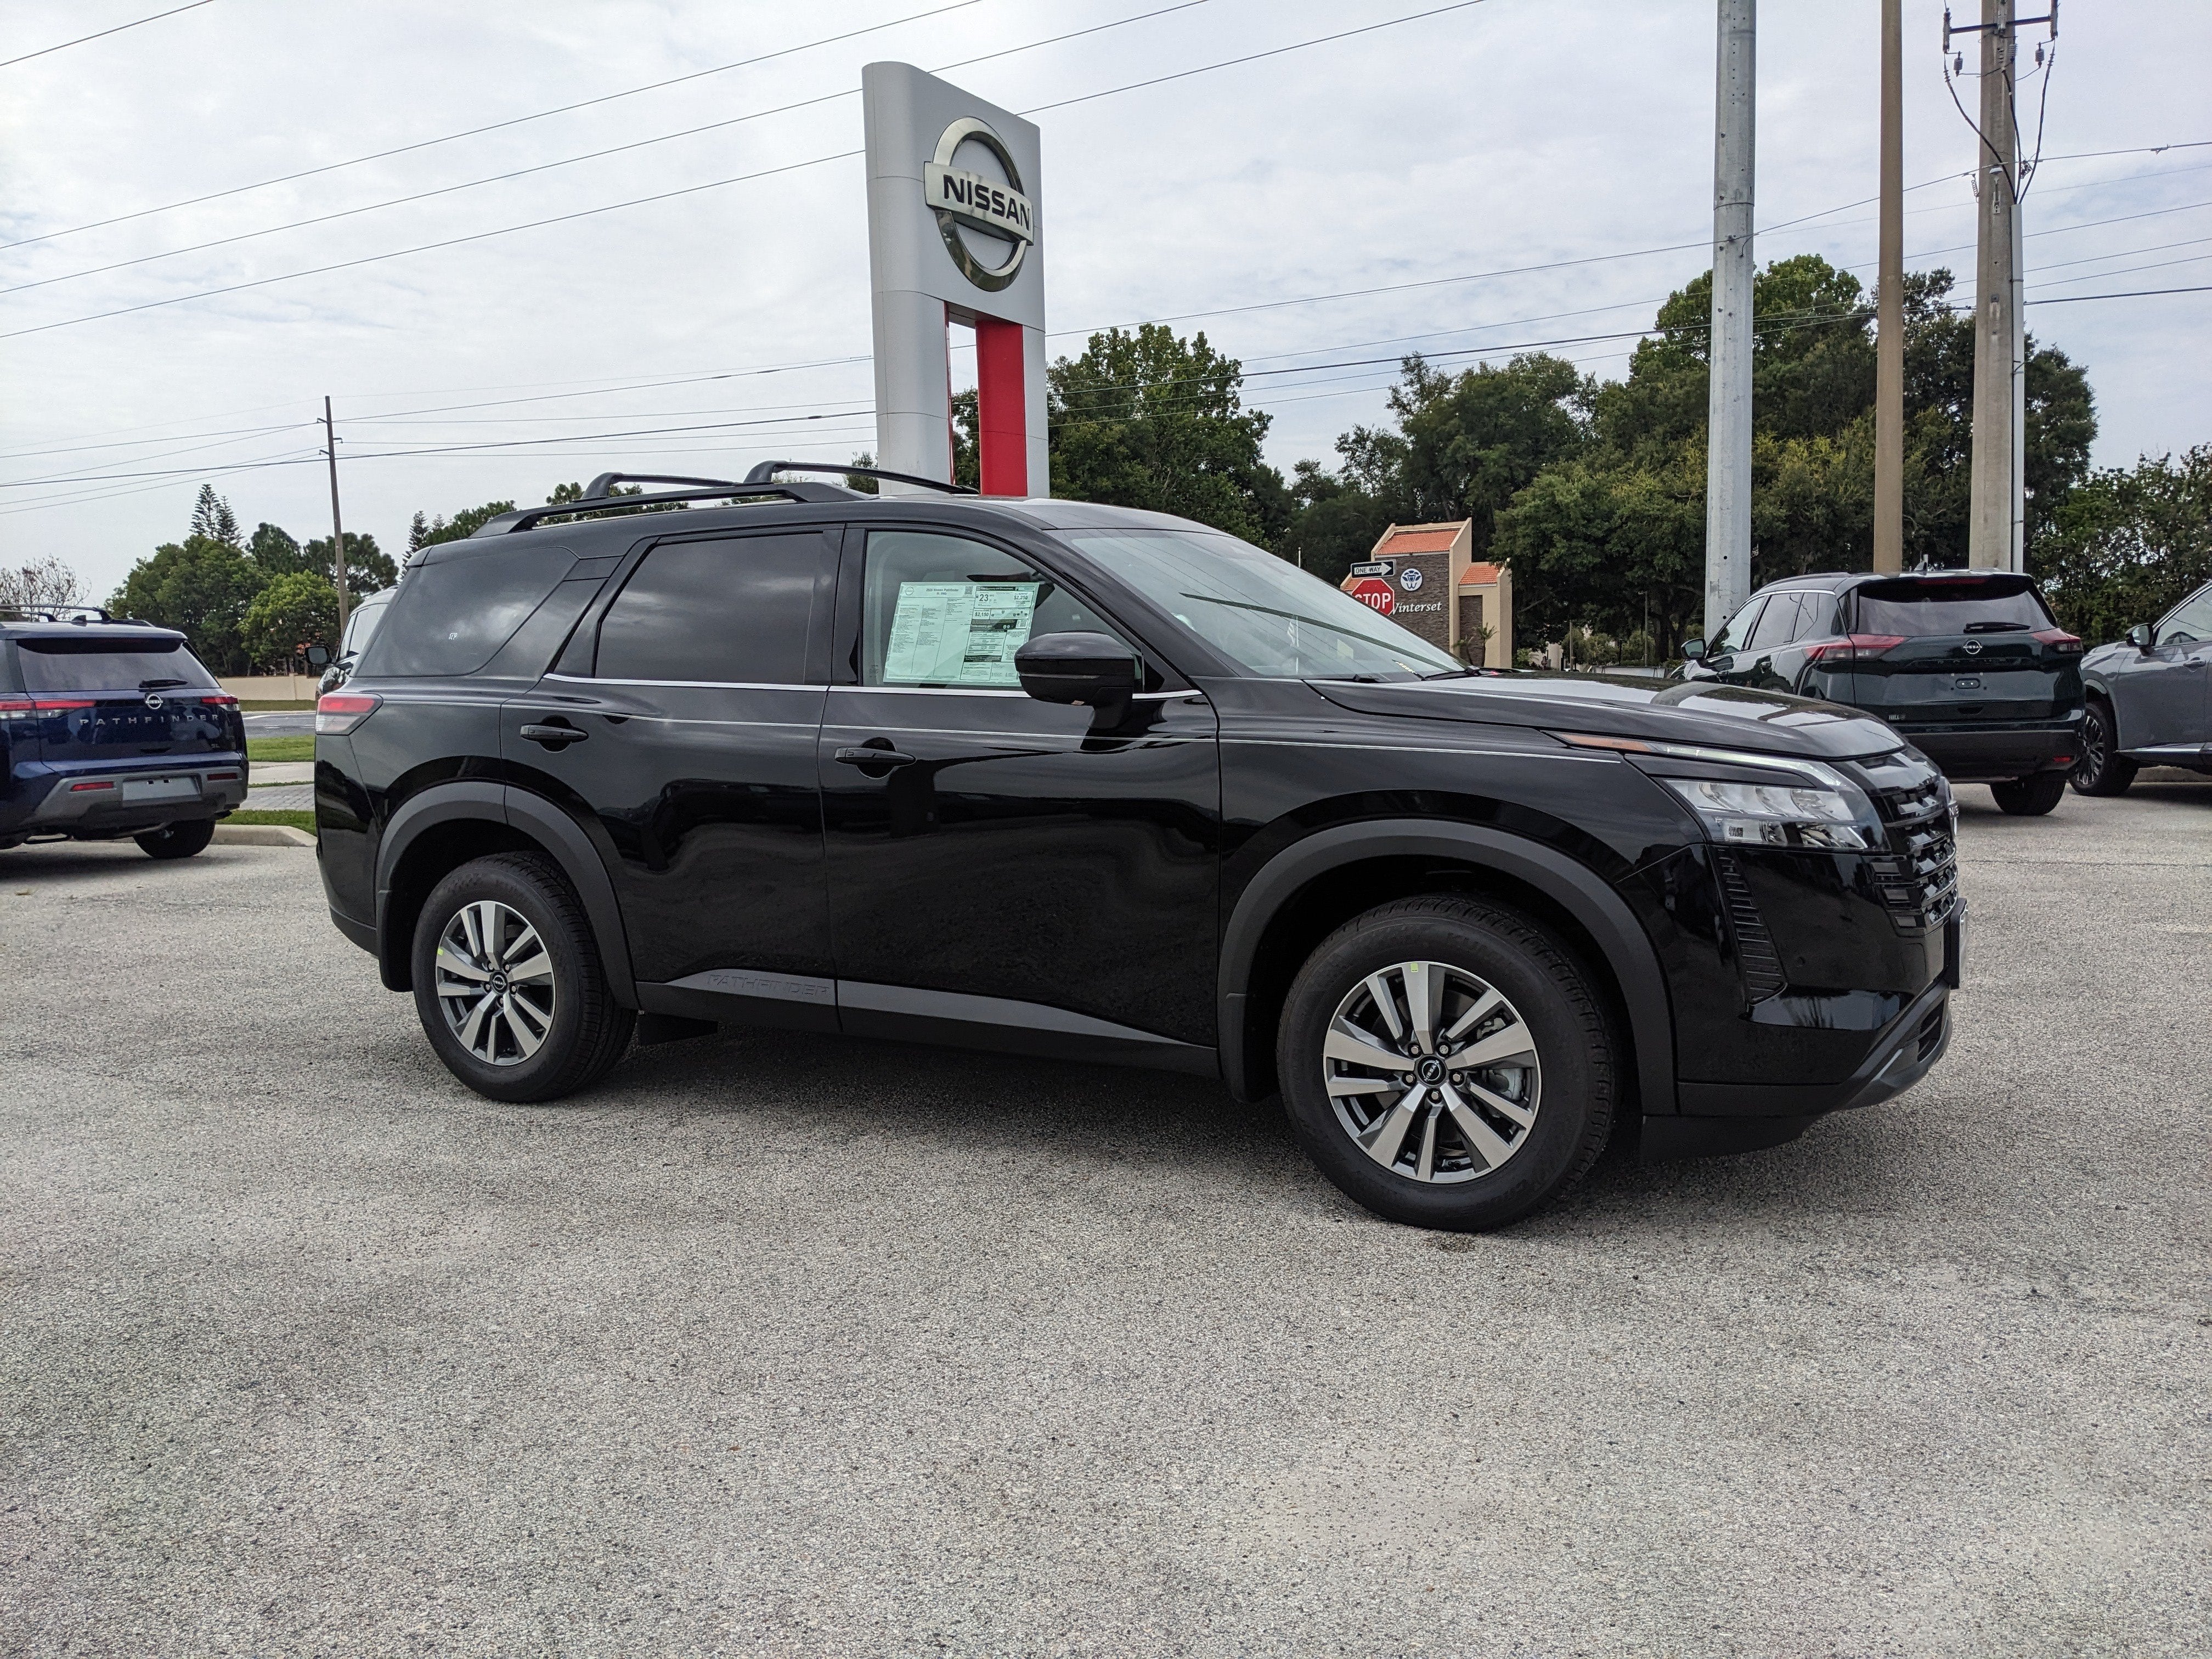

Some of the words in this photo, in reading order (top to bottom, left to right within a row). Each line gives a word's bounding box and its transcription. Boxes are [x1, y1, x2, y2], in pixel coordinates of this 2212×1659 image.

[943, 174, 1031, 231] NISSAN
[1355, 592, 1391, 610] TOP
[80, 715, 218, 725] PATHFINDER
[1424, 1060, 1440, 1082] NISSAN
